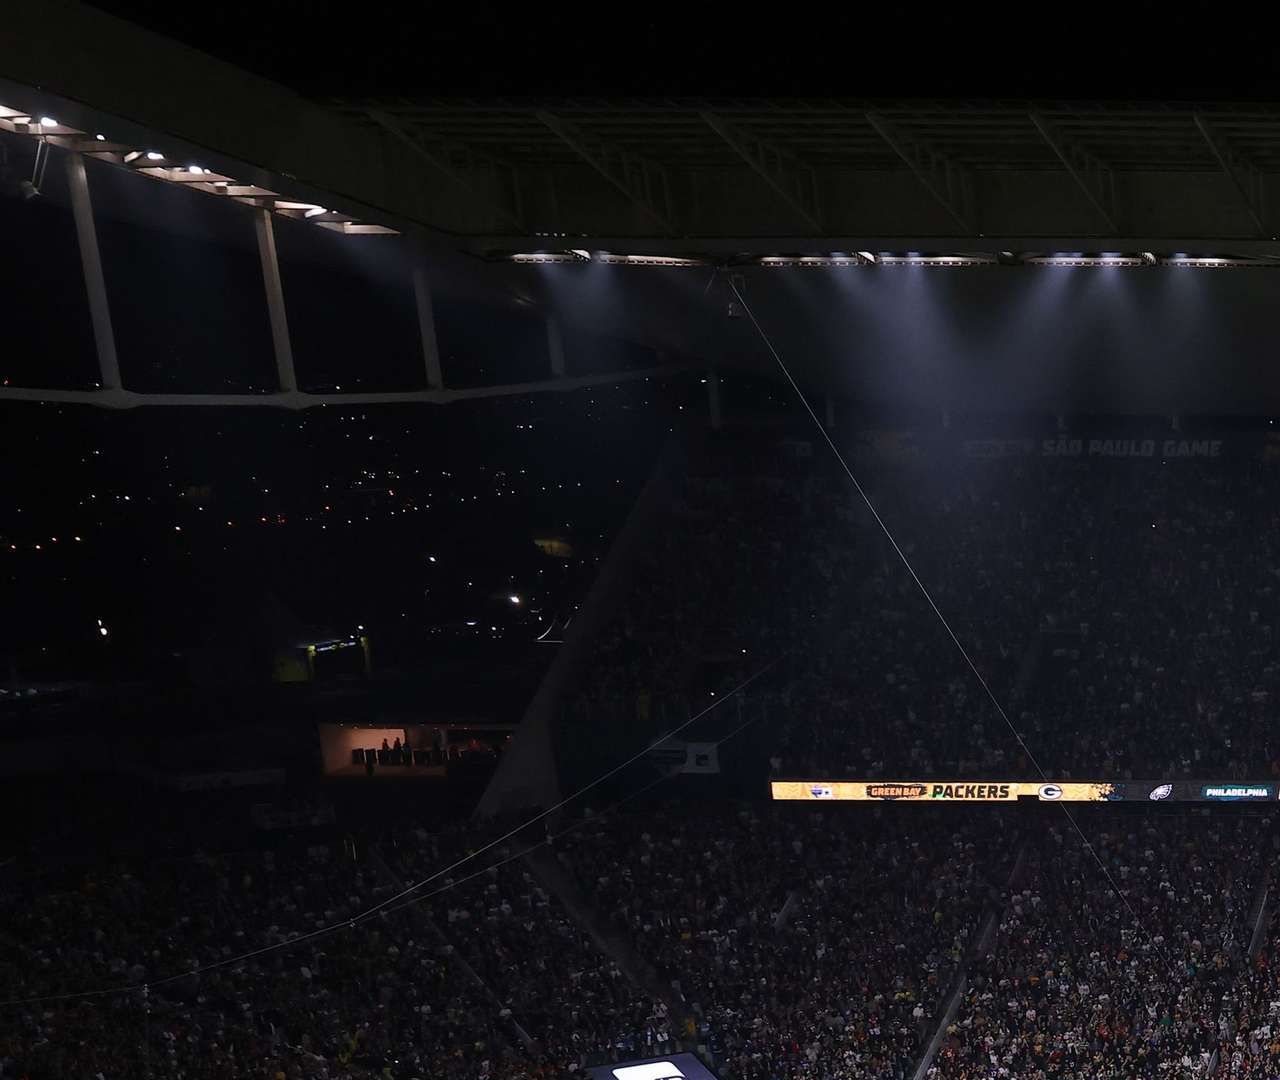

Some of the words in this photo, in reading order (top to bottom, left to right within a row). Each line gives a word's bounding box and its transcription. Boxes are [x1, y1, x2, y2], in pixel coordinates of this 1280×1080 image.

[1088, 439, 1155, 457] PAULO
[1163, 440, 1224, 457] GAME
[871, 787, 902, 797] GREEN
[903, 787, 921, 797] BAY
[932, 785, 1010, 799] PACKERS
[1206, 788, 1268, 797] PHILADELPHIA
